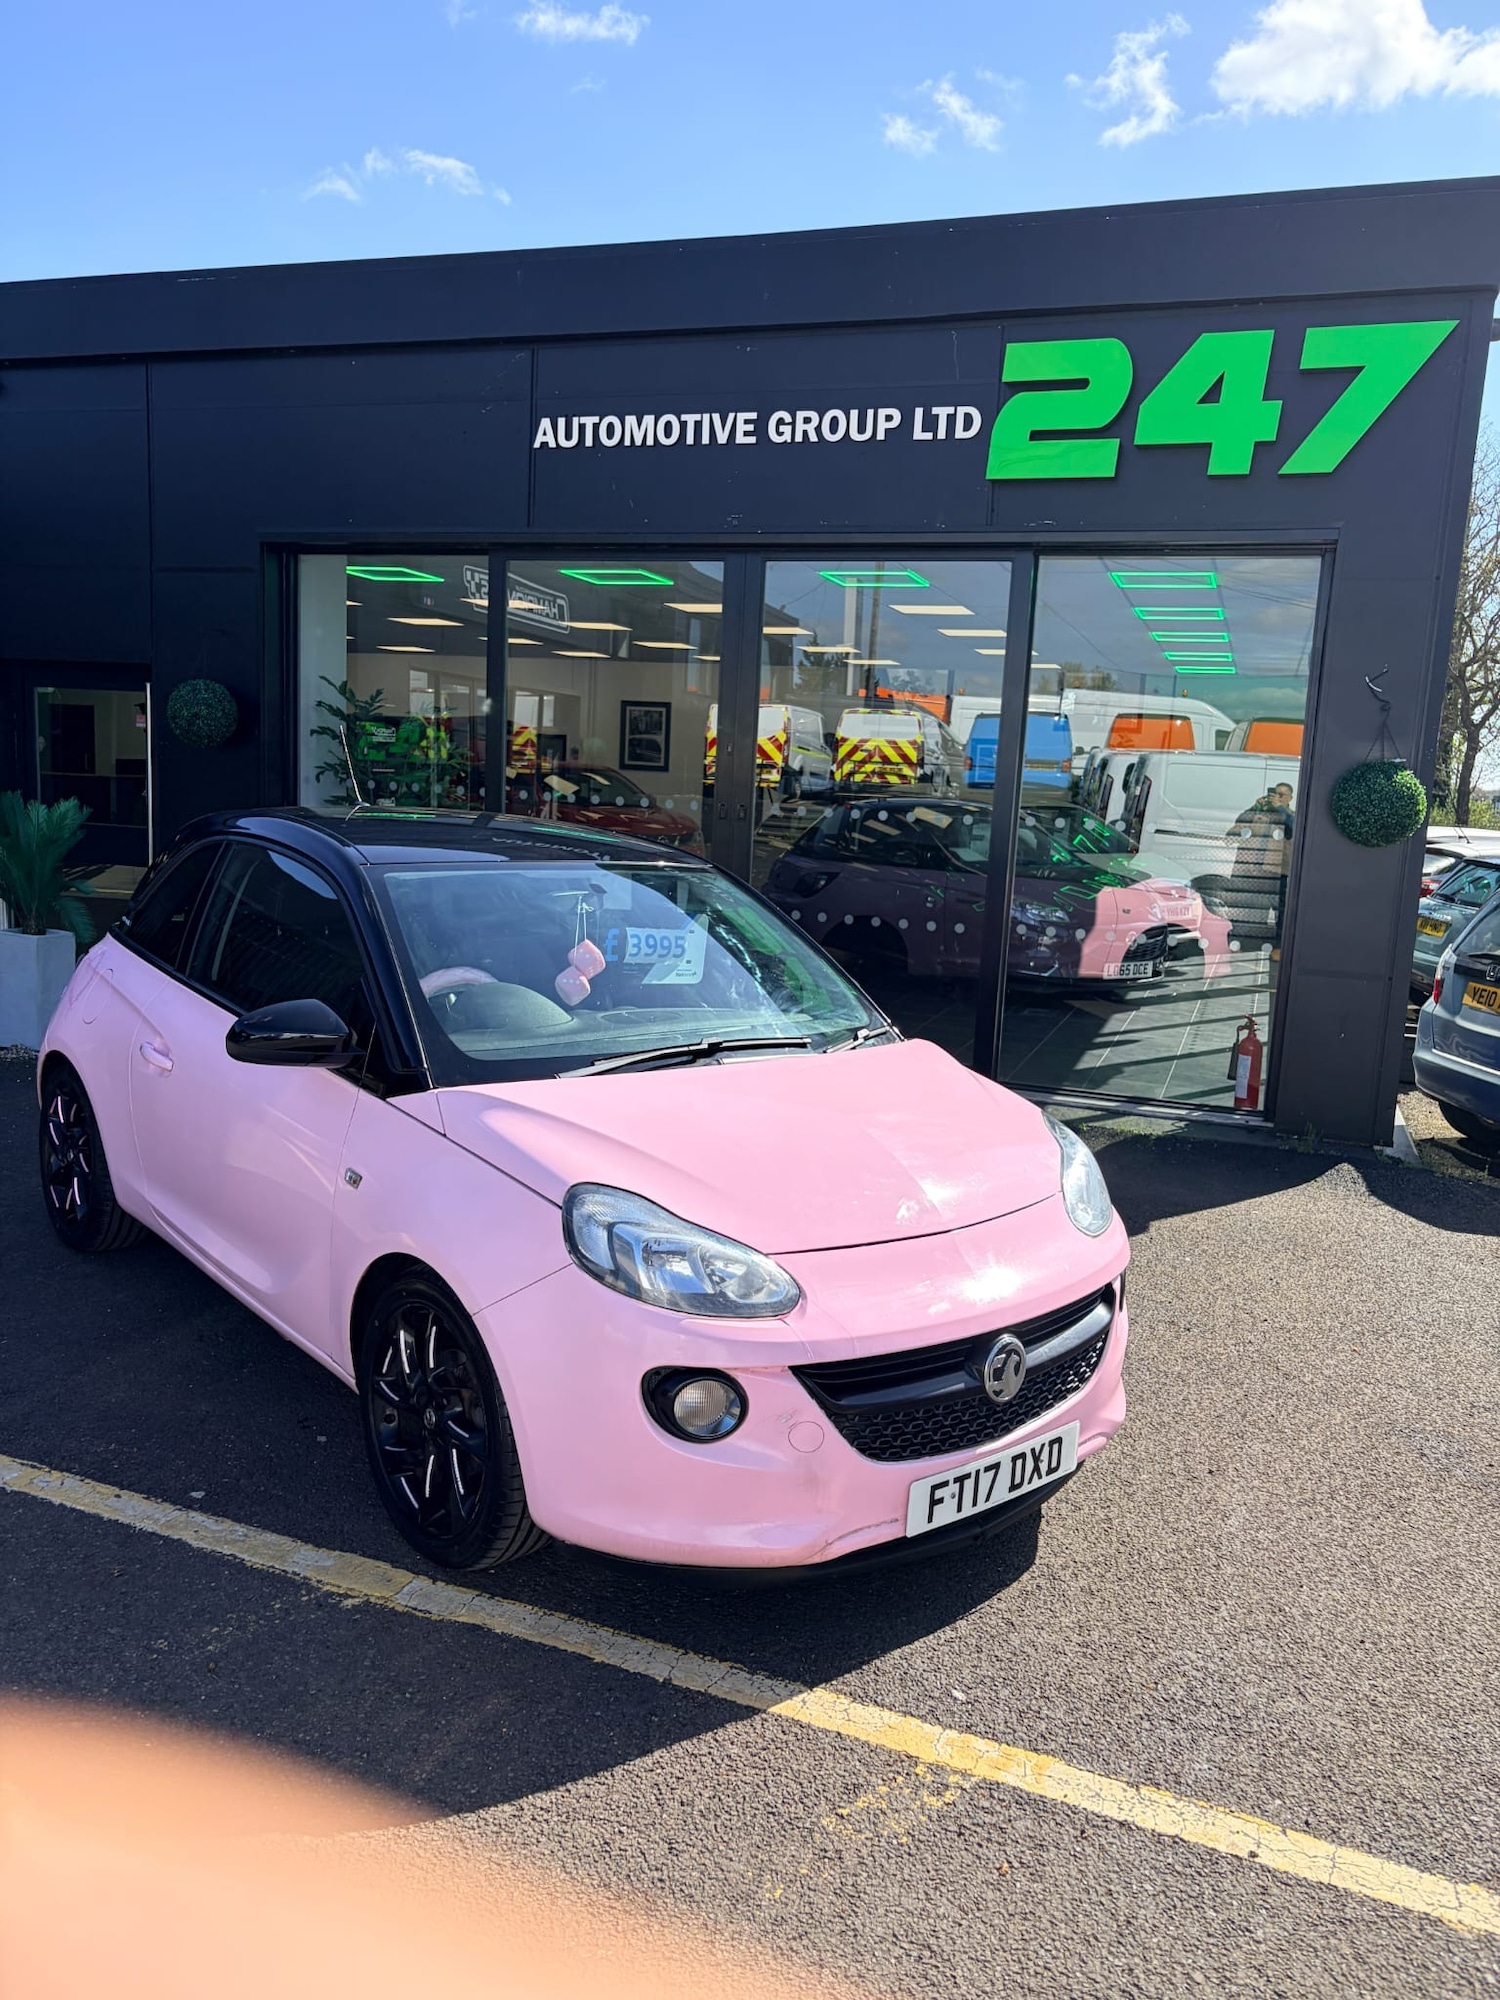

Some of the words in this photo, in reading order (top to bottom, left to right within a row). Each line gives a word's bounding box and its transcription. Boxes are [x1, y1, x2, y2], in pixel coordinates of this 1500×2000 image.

[533, 411, 757, 448] AUTOMOTIVE
[767, 407, 901, 443] GROUP
[912, 405, 982, 440] LTD
[985, 319, 1460, 479] 247
[927, 1461, 1001, 1523] FT17
[1008, 1436, 1062, 1493] DXD
